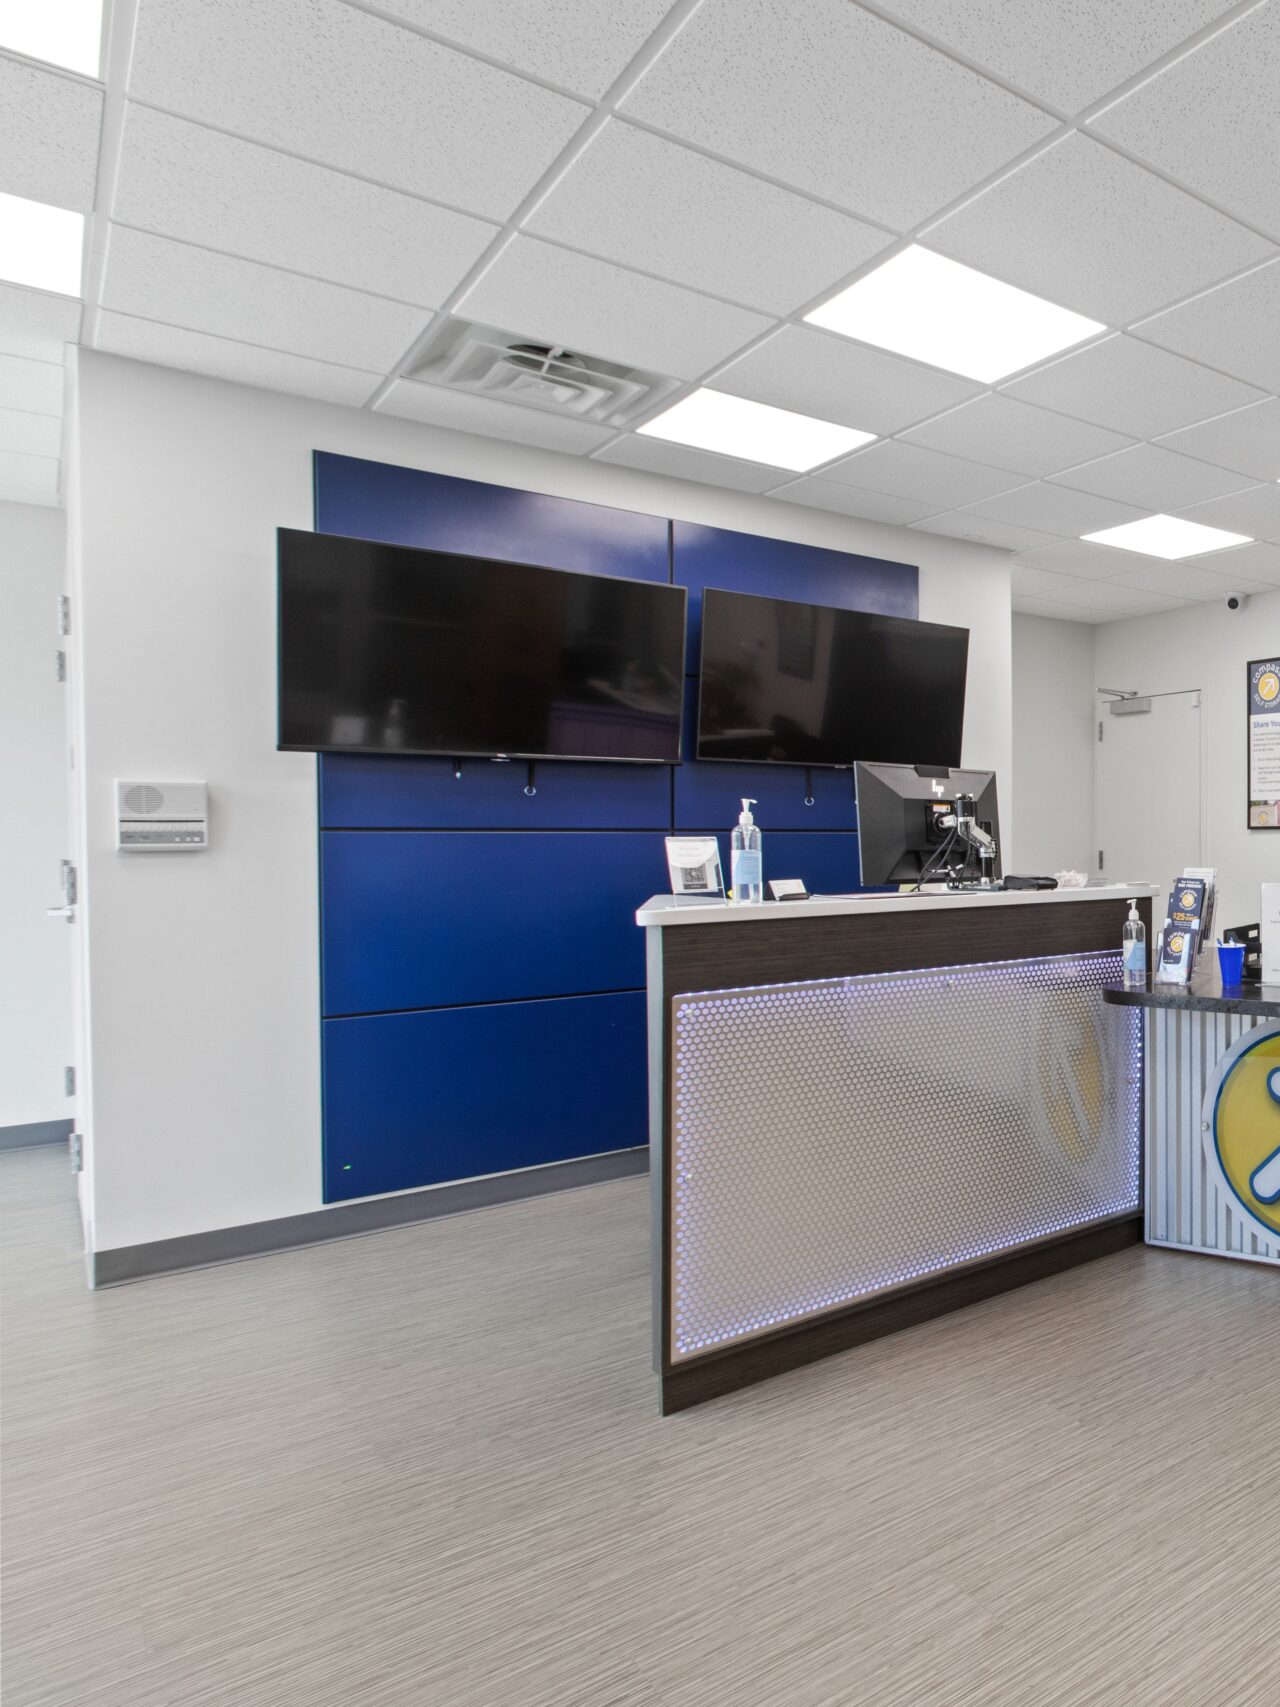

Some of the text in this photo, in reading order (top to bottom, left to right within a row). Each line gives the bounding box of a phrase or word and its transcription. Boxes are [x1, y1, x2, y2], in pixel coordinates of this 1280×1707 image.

[1253, 693, 1264, 706] SELF
[1253, 720, 1269, 729] Share
[932, 779, 944, 798] hp
[1173, 912, 1185, 920] $25
